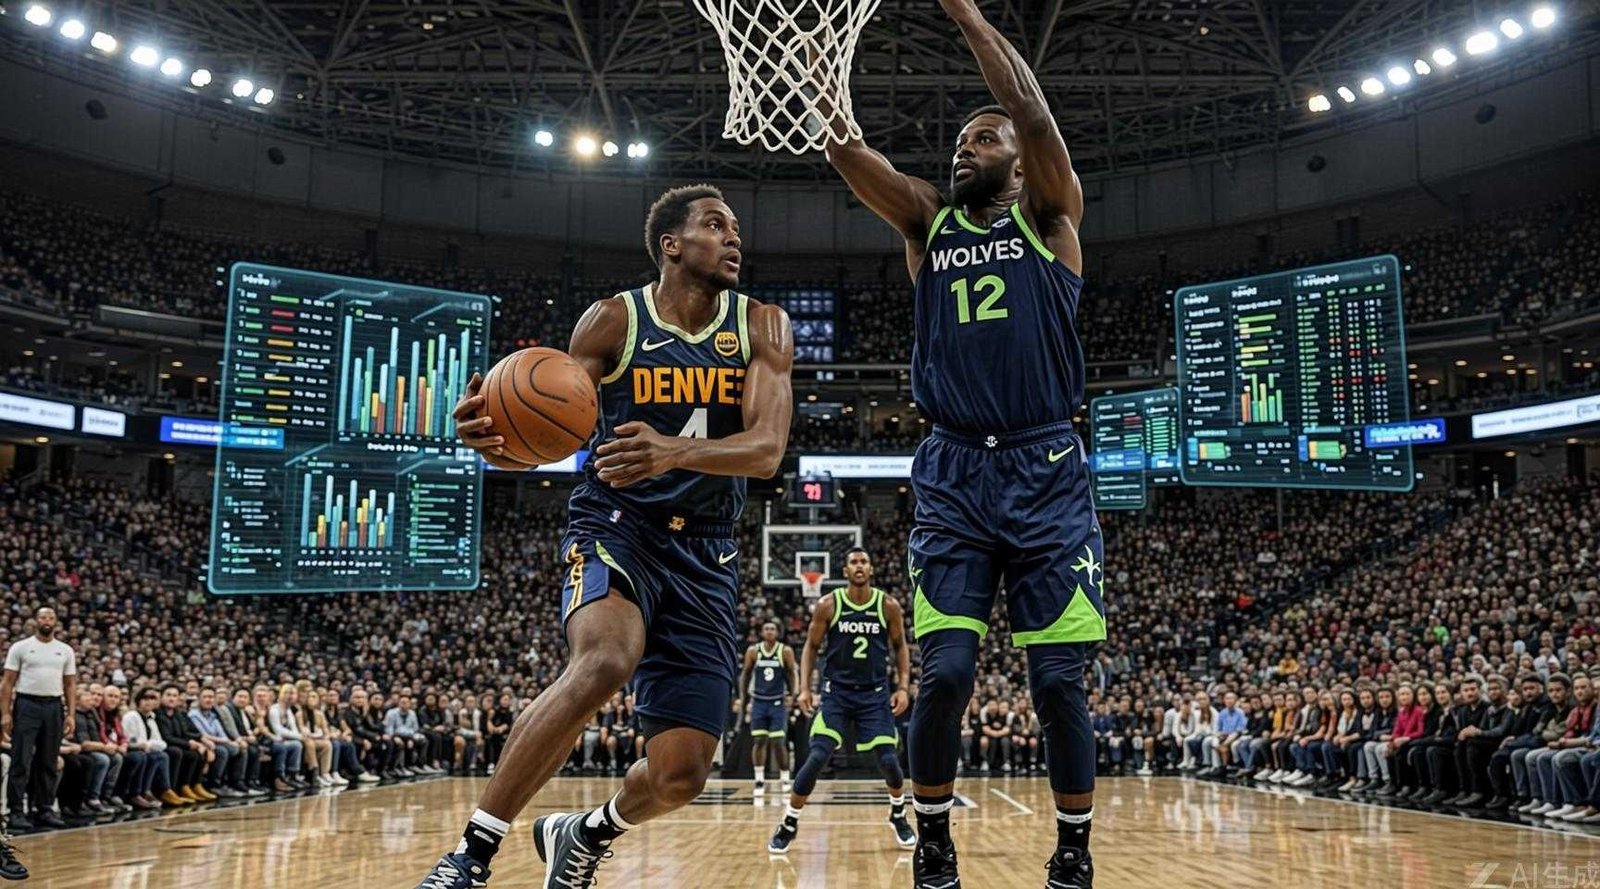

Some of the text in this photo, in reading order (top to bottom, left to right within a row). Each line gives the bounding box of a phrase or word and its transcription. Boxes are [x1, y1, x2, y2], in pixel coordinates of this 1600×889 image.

[931, 238, 1025, 272] WOLVES
[951, 275, 1008, 324] 12
[853, 636, 868, 659] 2
[763, 667, 775, 682] 9
